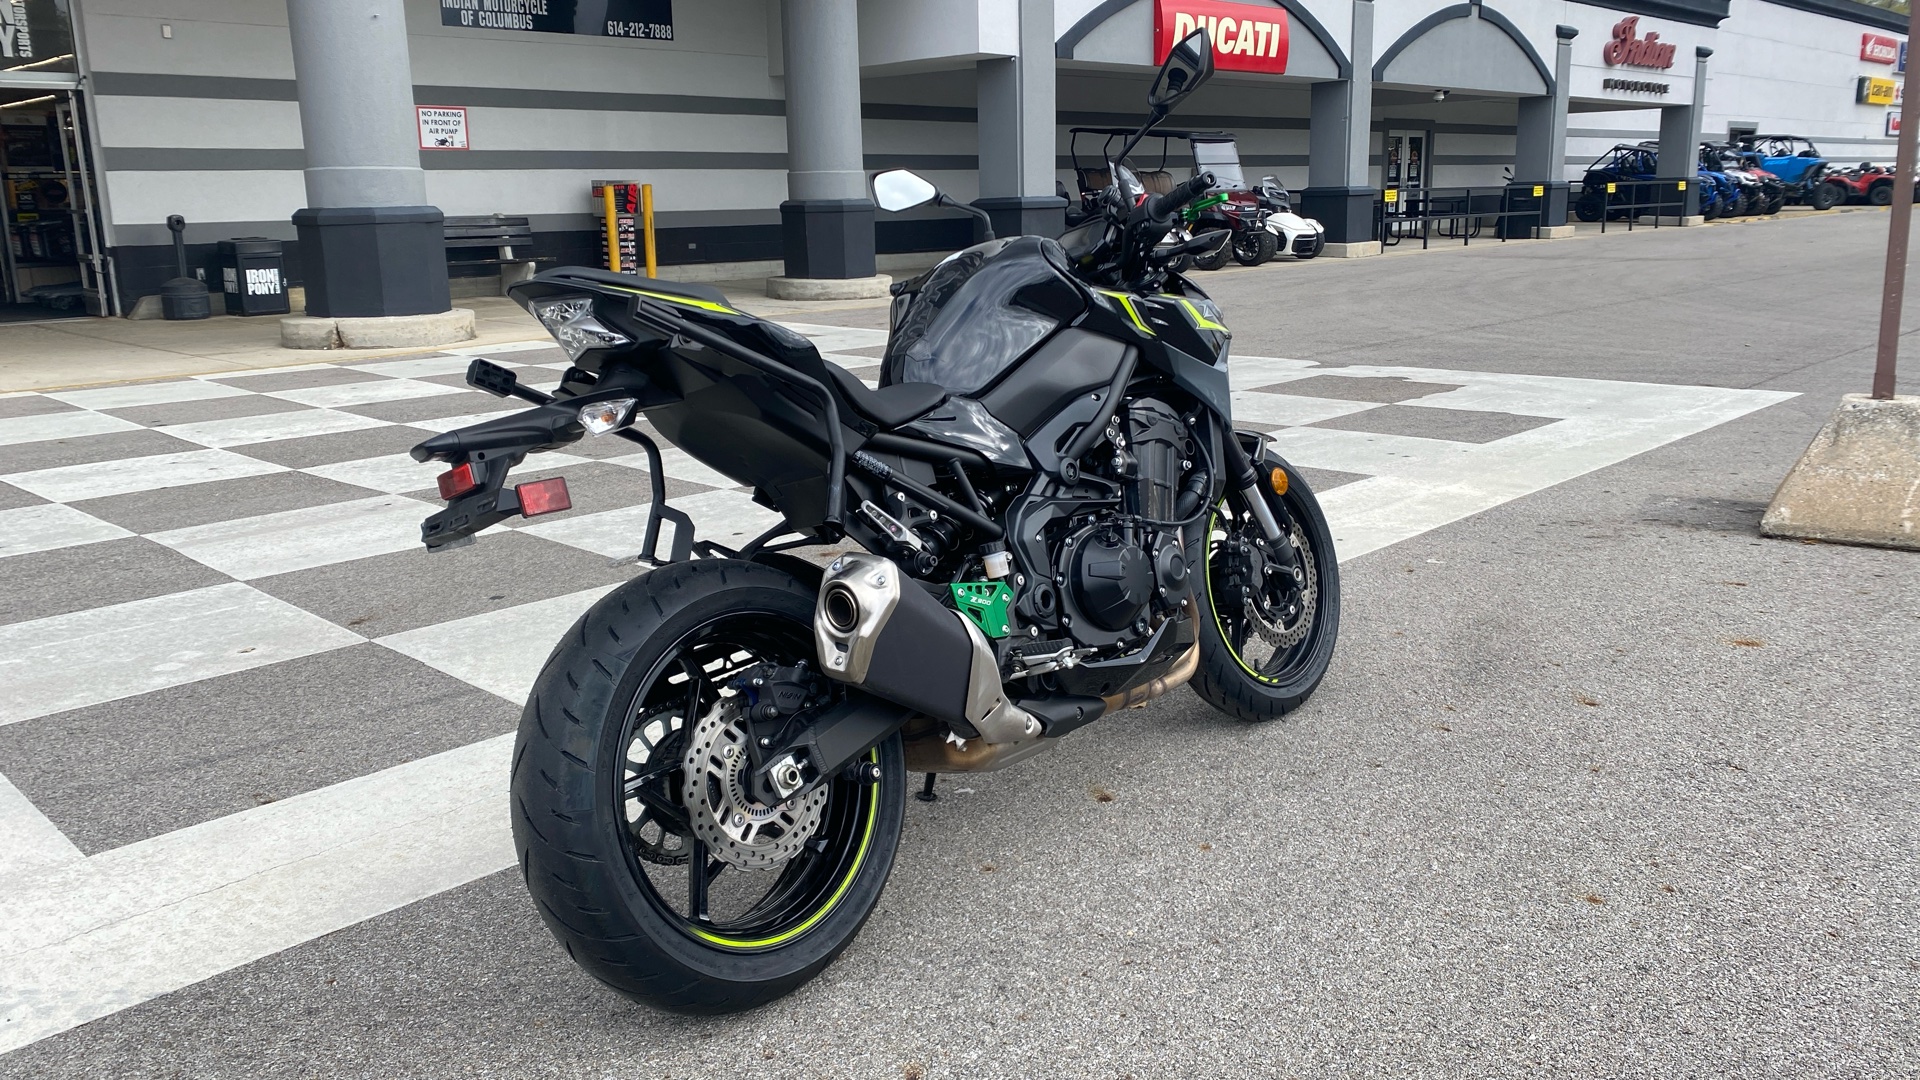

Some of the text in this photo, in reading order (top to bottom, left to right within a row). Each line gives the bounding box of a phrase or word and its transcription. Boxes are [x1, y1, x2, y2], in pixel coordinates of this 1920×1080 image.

[461, 10, 533, 30] OF COLUMBUS
[607, 20, 672, 39] 614-212-7888
[626, 183, 638, 214] AIR
[245, 269, 275, 284] IRON
[247, 283, 275, 296] PONY
